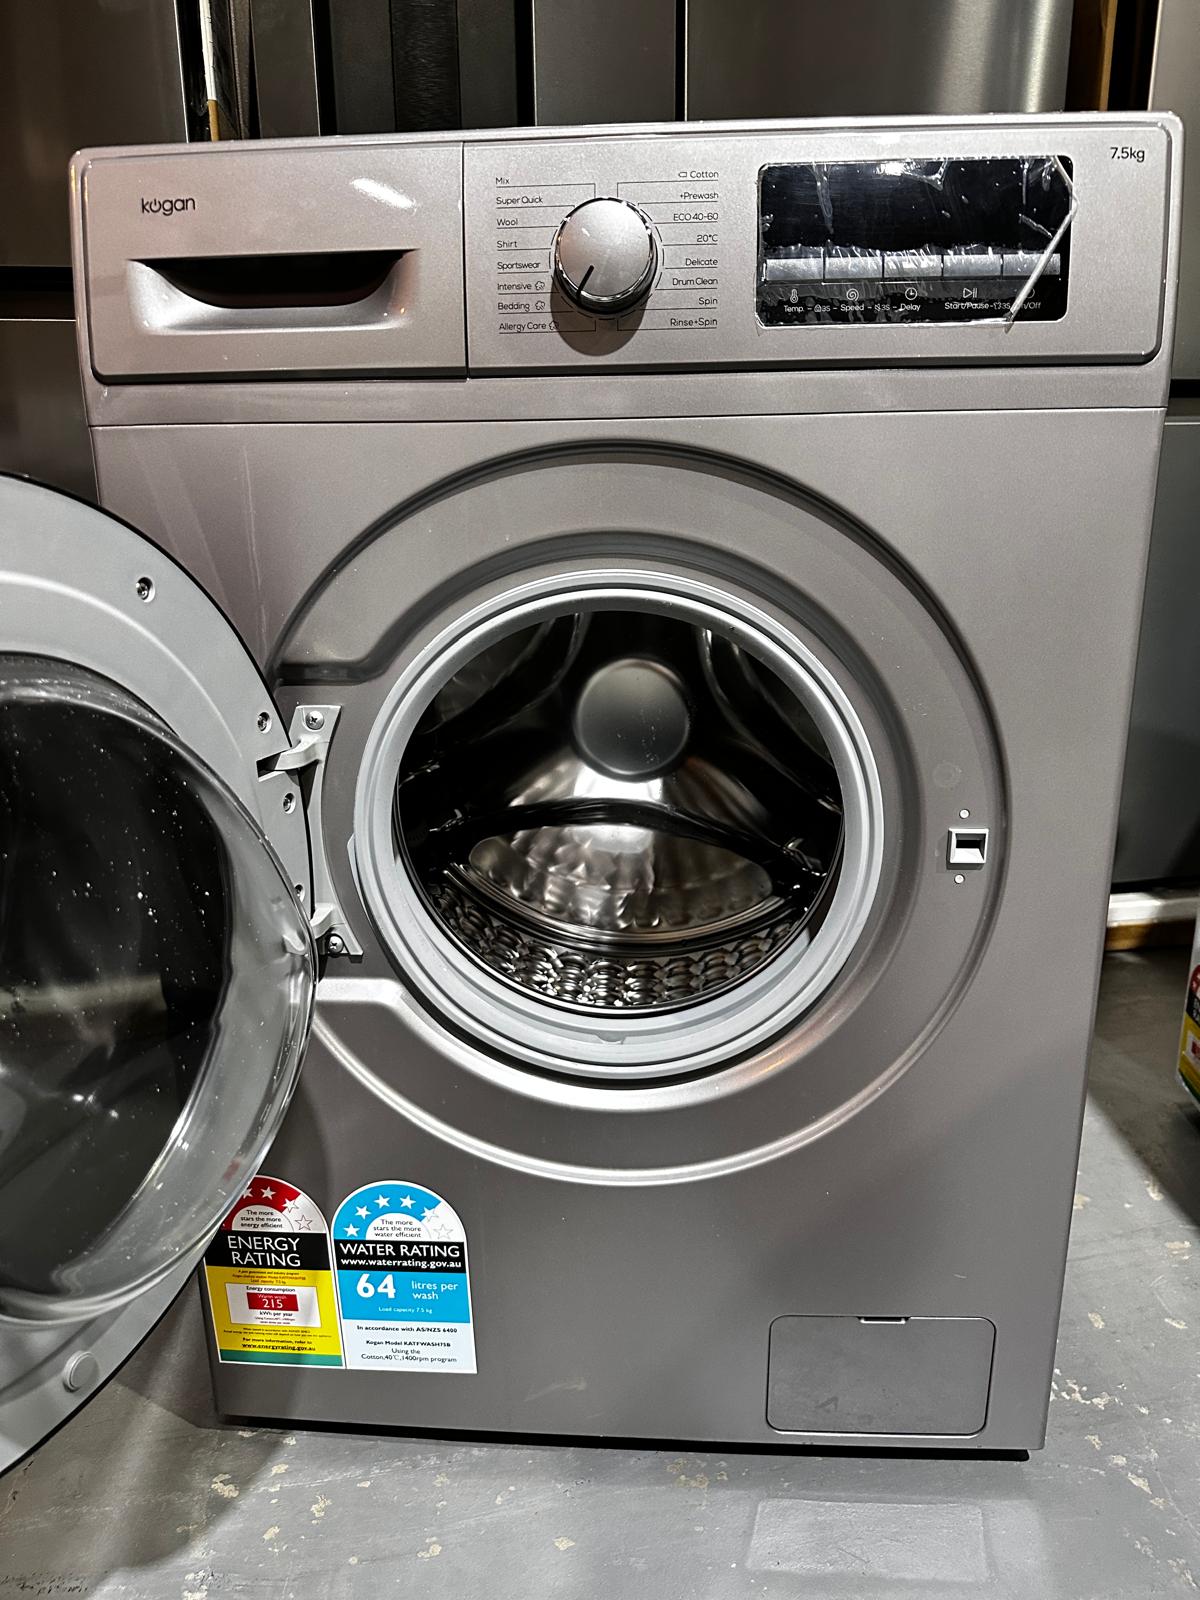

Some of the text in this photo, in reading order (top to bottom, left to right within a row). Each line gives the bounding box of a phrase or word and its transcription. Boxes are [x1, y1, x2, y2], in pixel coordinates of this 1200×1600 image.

[1110, 147, 1145, 163] 7.5kg
[690, 170, 719, 178] Cotton
[496, 195, 543, 205] Super Quick
[141, 197, 196, 216] kogan
[673, 212, 719, 221] ECO 40-60
[497, 218, 519, 226] Wool
[696, 233, 718, 242] 20°C
[496, 240, 518, 248] Shirt
[497, 261, 541, 270] Sportswear
[685, 257, 719, 266] Delicate
[672, 277, 719, 286] Drum Clean
[698, 296, 718, 306] Spin
[497, 302, 531, 312] Bedding
[840, 303, 865, 312] Speed
[900, 303, 920, 311] Delay
[499, 321, 547, 333] Allergy Care
[227, 1235, 300, 1251] ENERGY
[339, 1242, 460, 1258] WATER RATING
[231, 1251, 301, 1267] RATING
[340, 1258, 462, 1269] www.waterrating.gov.au
[356, 1273, 396, 1298] 64
[411, 1280, 459, 1292] litres per
[412, 1291, 439, 1300] wash
[262, 1298, 284, 1308] 215
[391, 1347, 409, 1355] Using
[430, 1355, 458, 1363] program
